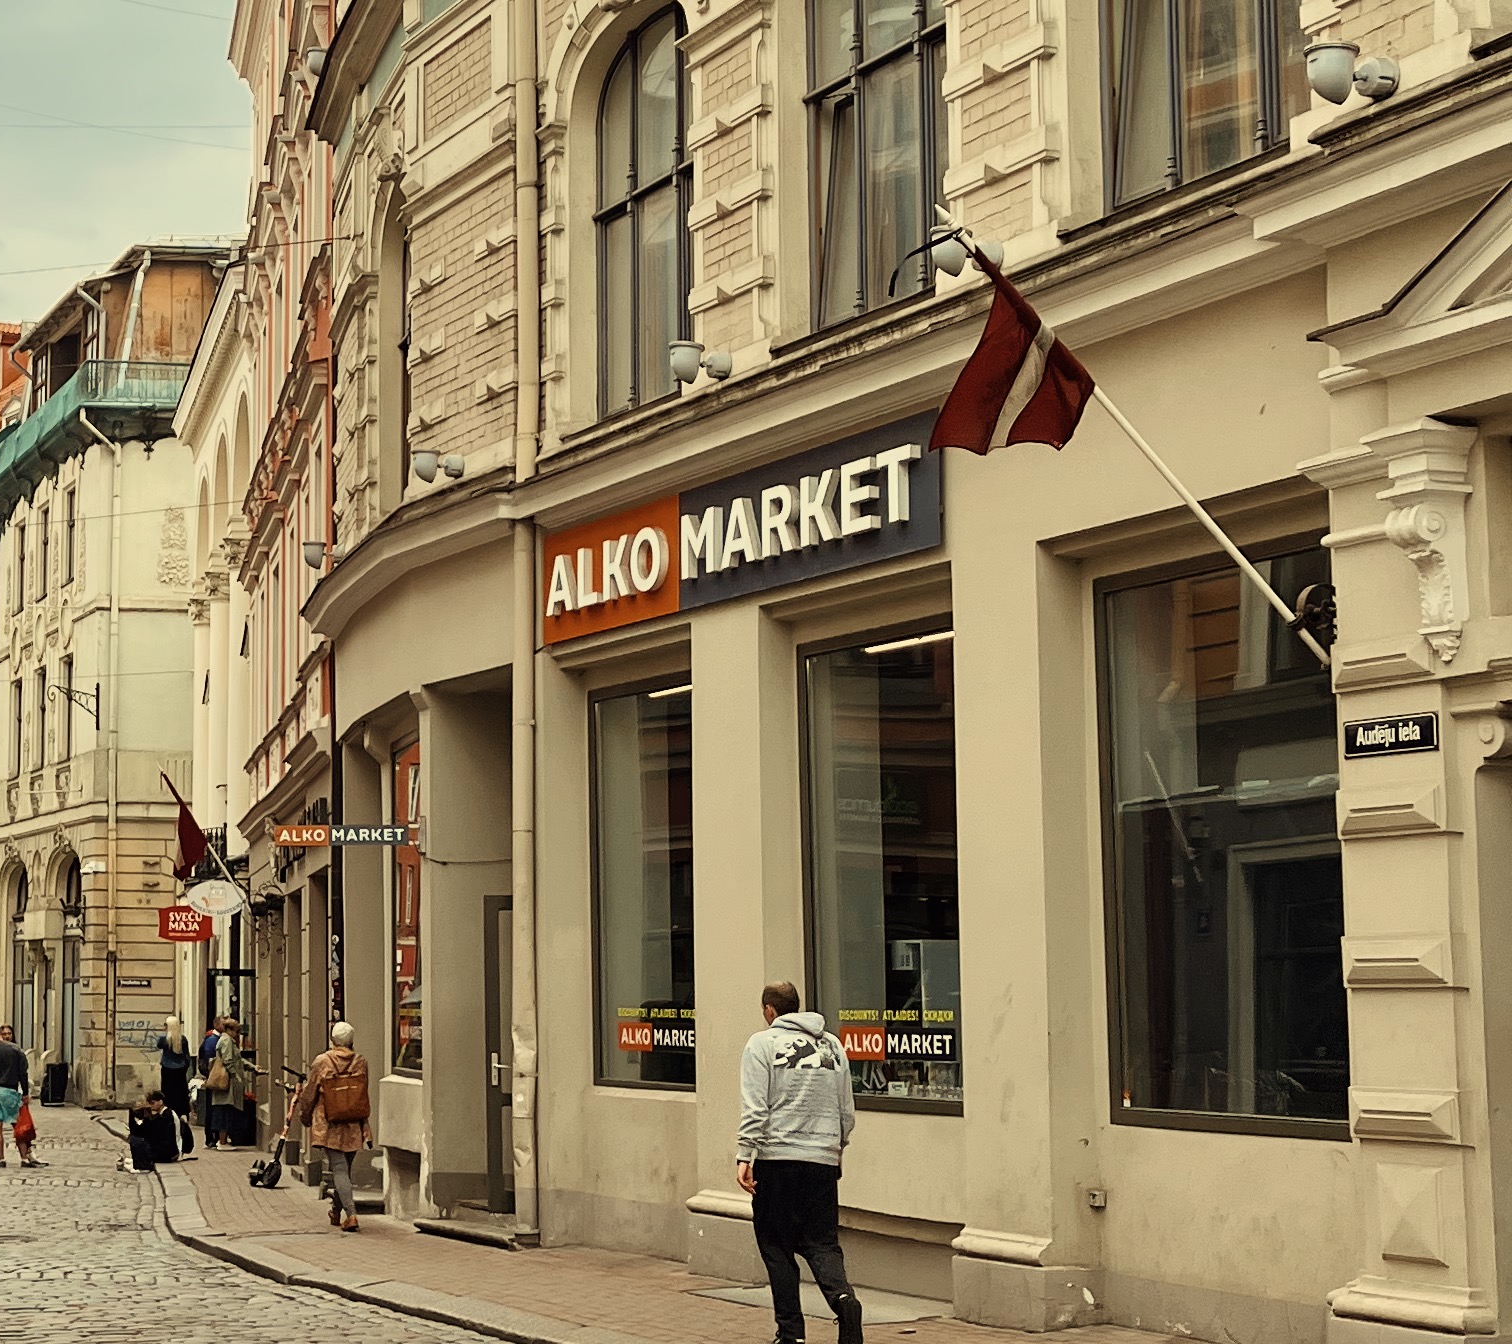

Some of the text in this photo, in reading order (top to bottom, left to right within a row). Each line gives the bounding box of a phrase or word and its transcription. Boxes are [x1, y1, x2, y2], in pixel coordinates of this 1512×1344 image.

[546, 444, 921, 617] ALKO MARKET
[1356, 721, 1420, 747] Audēju iela
[279, 828, 405, 842] ALKO MARKET
[621, 1027, 695, 1047] ALKO MARKE
[844, 1033, 953, 1055] ALKO MARKET
